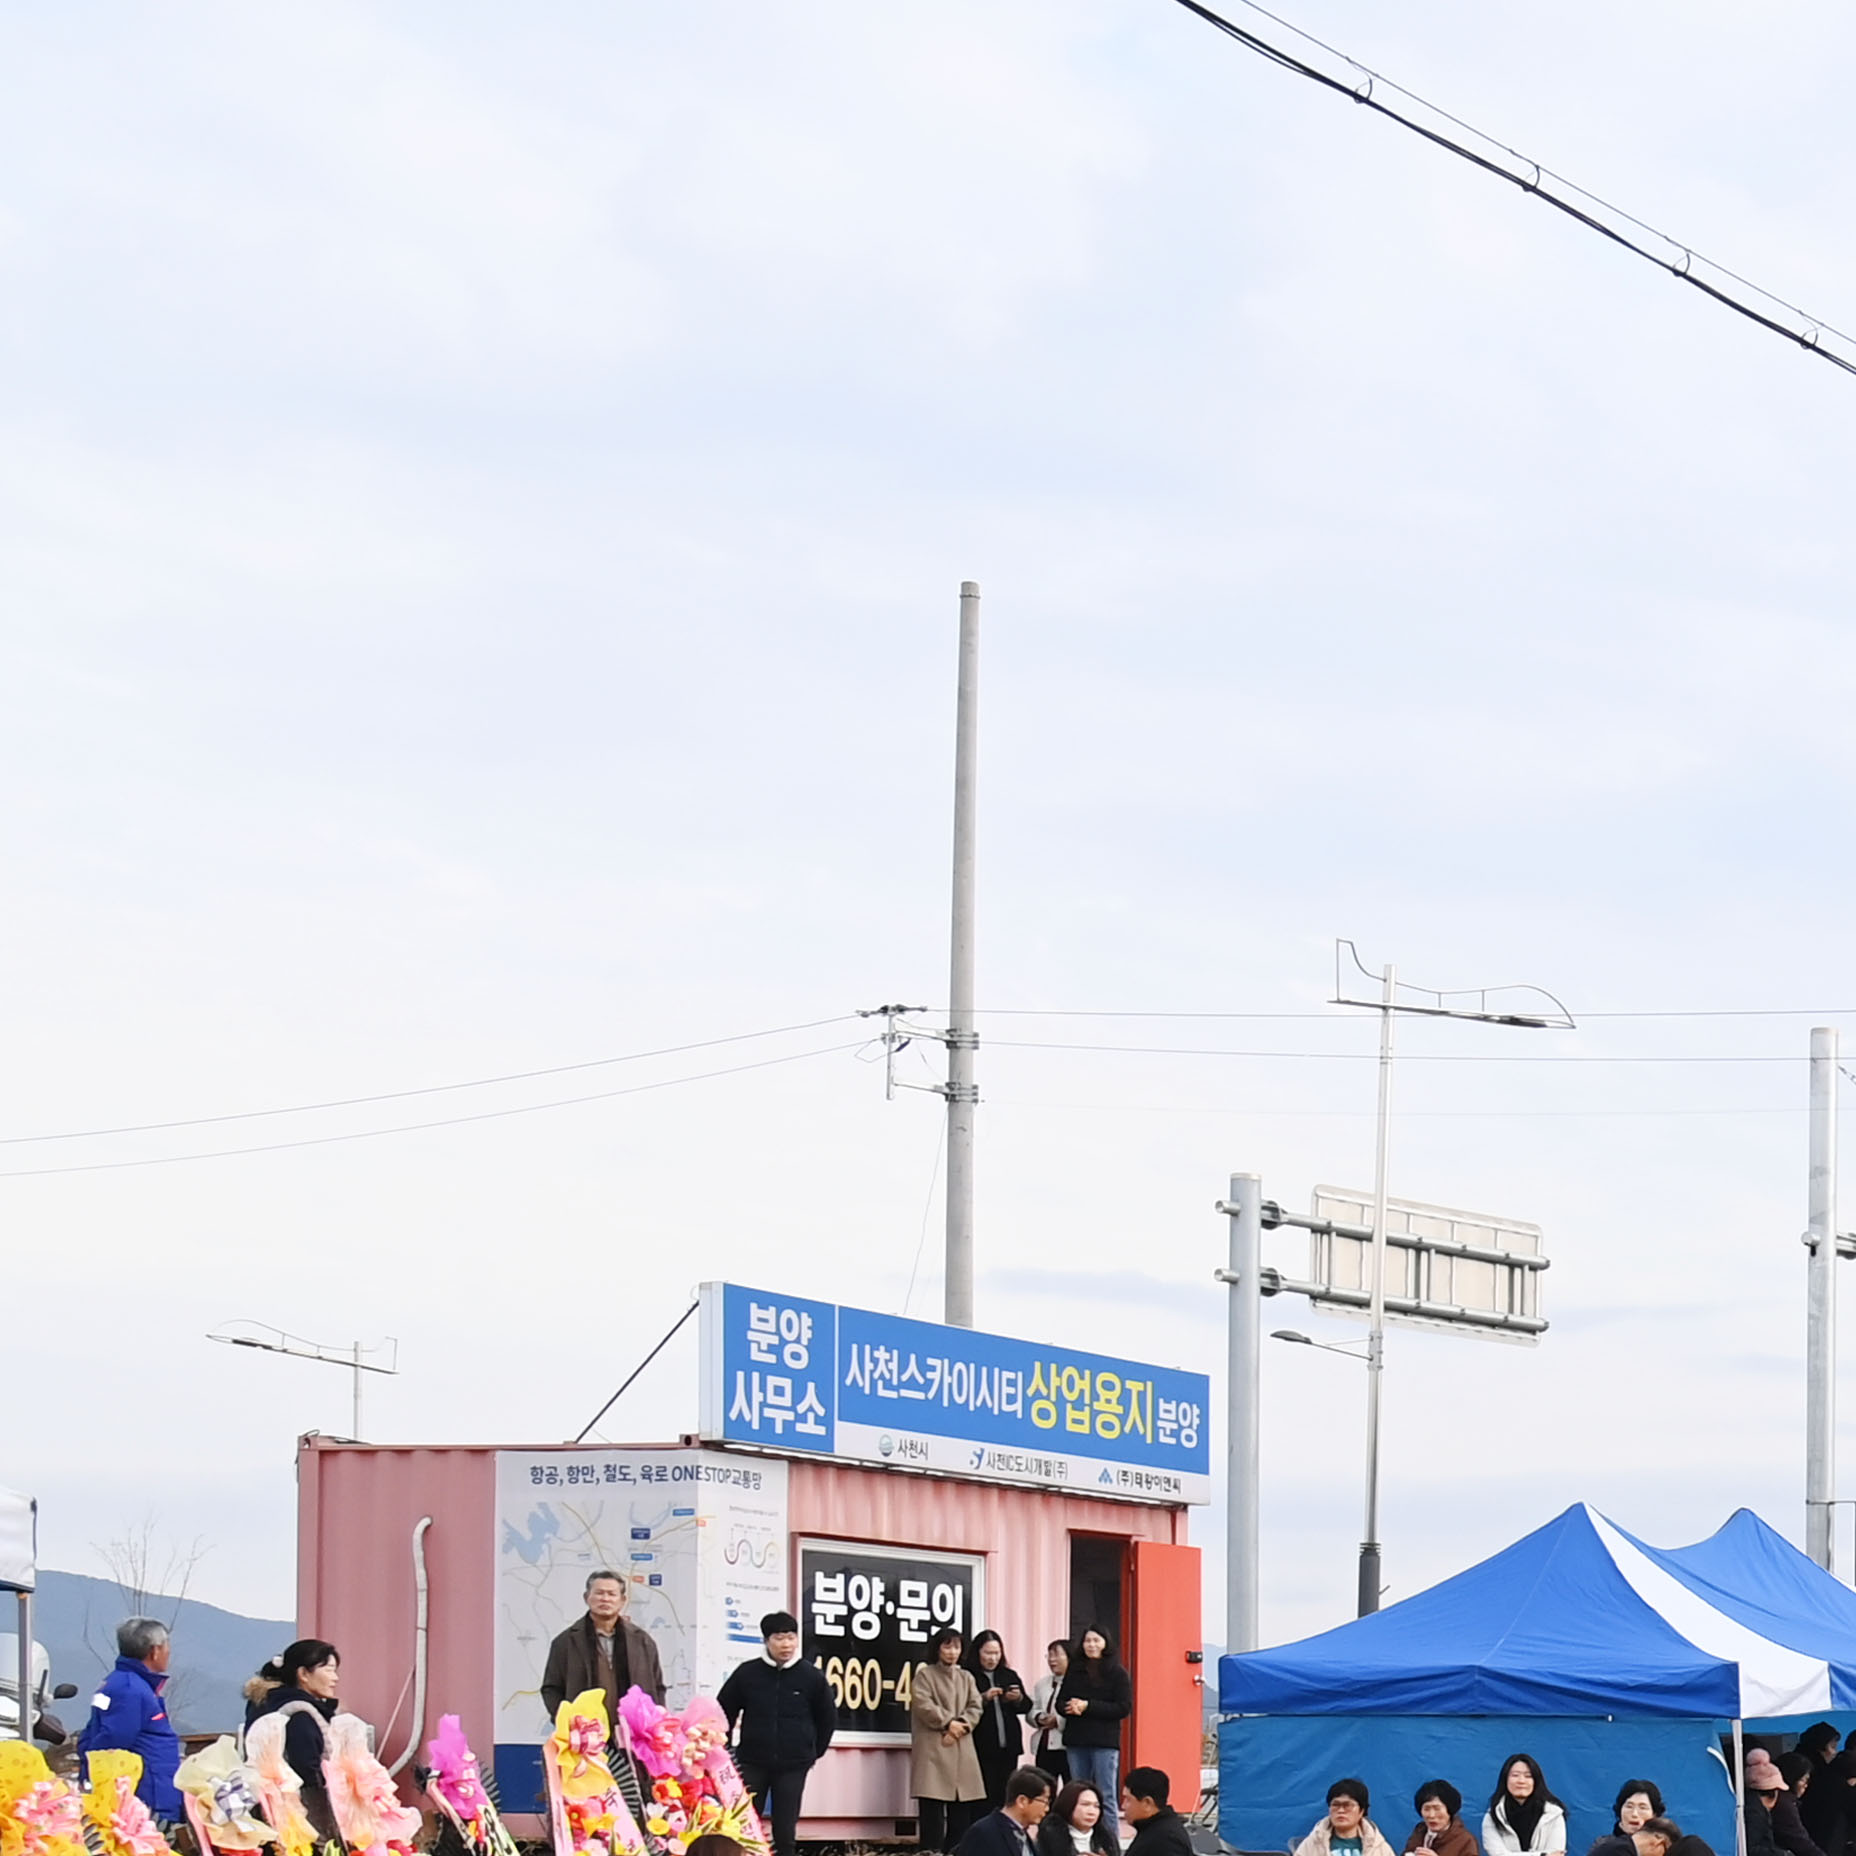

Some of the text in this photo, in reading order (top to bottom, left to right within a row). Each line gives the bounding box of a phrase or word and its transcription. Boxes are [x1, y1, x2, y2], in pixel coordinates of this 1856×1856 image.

[747, 1302, 813, 1370] 분양
[729, 1371, 826, 1436] 사무소
[845, 1344, 1200, 1448] 사천스카이시티 상업용지 분양
[530, 1466, 563, 1486] 항공,
[567, 1466, 600, 1486] 항만,
[603, 1464, 637, 1486] 철도,
[897, 1439, 929, 1462] 사천시
[814, 1655, 928, 1711] 660-4
